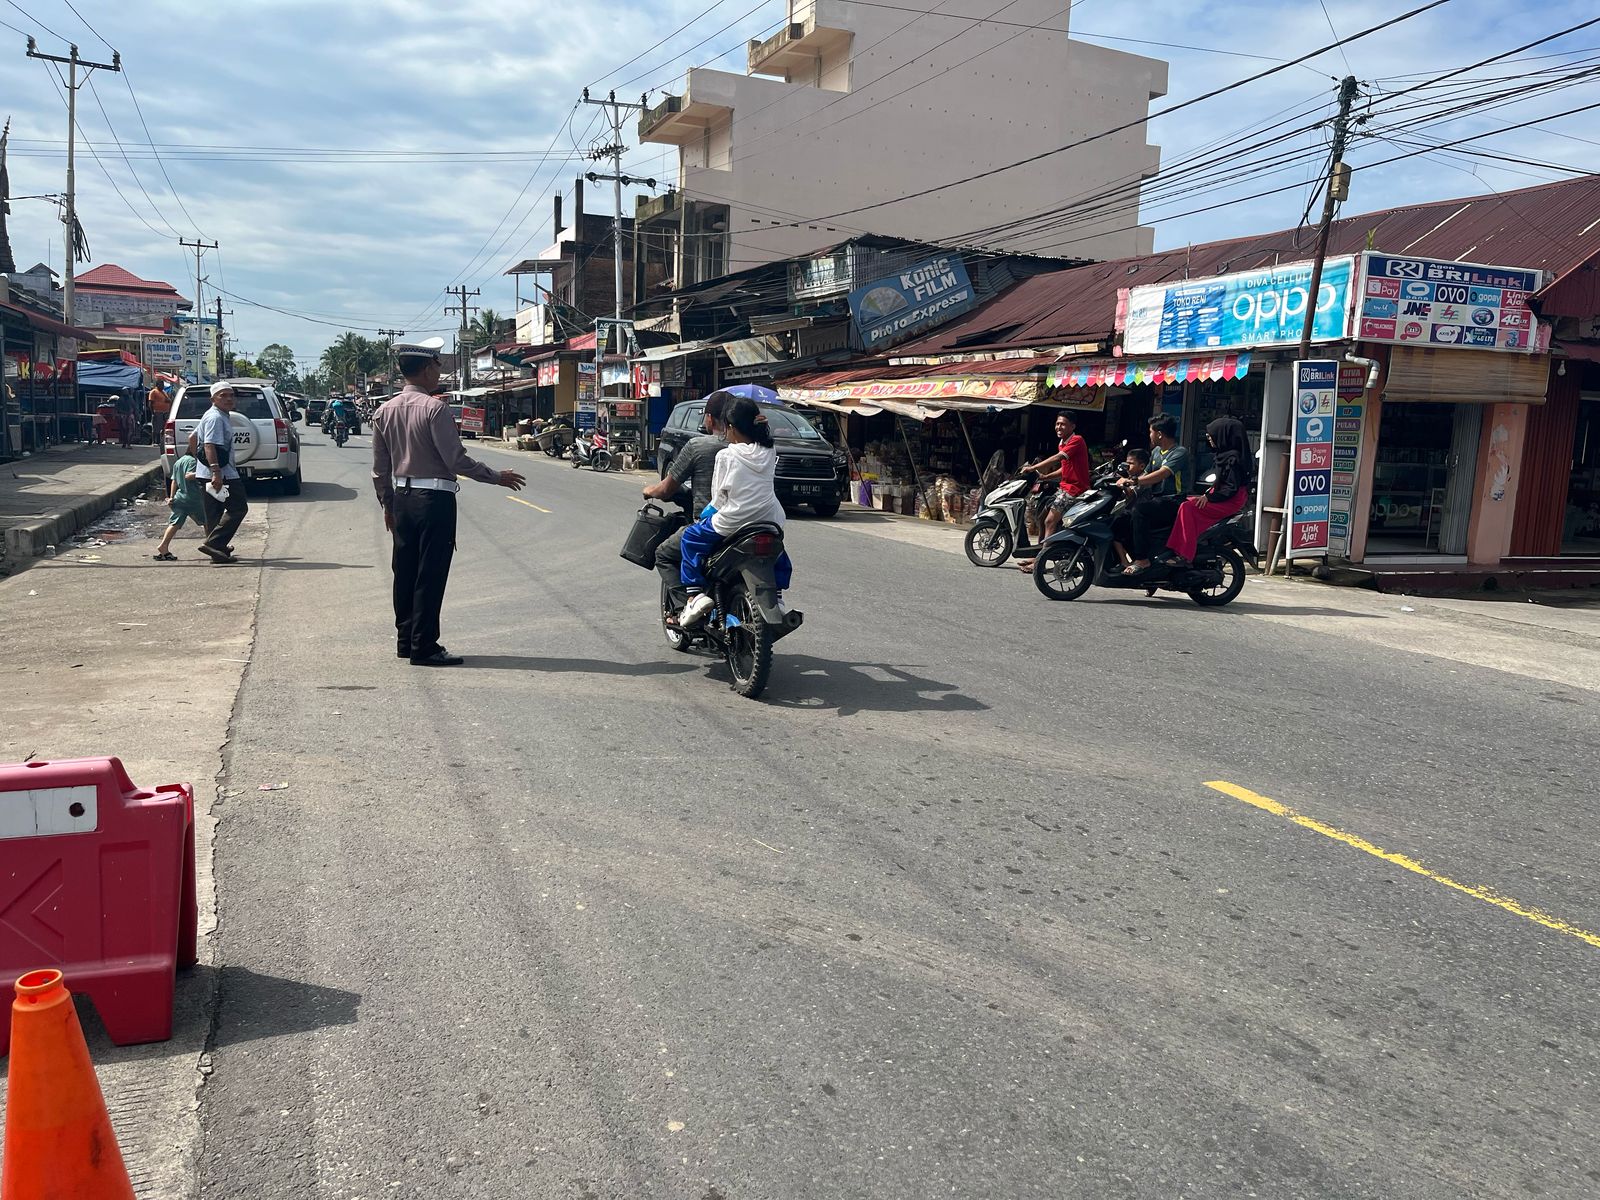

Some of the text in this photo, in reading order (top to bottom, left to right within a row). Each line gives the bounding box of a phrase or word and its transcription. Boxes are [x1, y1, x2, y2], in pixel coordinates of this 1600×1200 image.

[1247, 271, 1314, 288] DIVA CELLULA
[1427, 268, 1522, 287] BRILink
[914, 271, 957, 301] FILM
[1381, 286, 1398, 297] Pay
[1173, 294, 1207, 306] TOKO RENI
[1438, 286, 1466, 303] OVO
[1478, 293, 1501, 303] gopay
[1506, 291, 1527, 300] Link
[912, 296, 962, 320] Express
[1232, 282, 1337, 329] oppo
[1402, 301, 1432, 317] JNE
[1501, 314, 1519, 326] 4G
[1242, 327, 1319, 342] SMART PHOE
[1310, 371, 1335, 380] BRILink
[1312, 453, 1326, 466] Pay
[1299, 475, 1326, 492] OVO
[1303, 505, 1328, 514] gopay
[1301, 524, 1319, 533] Link
[1301, 532, 1317, 542] Aja!
